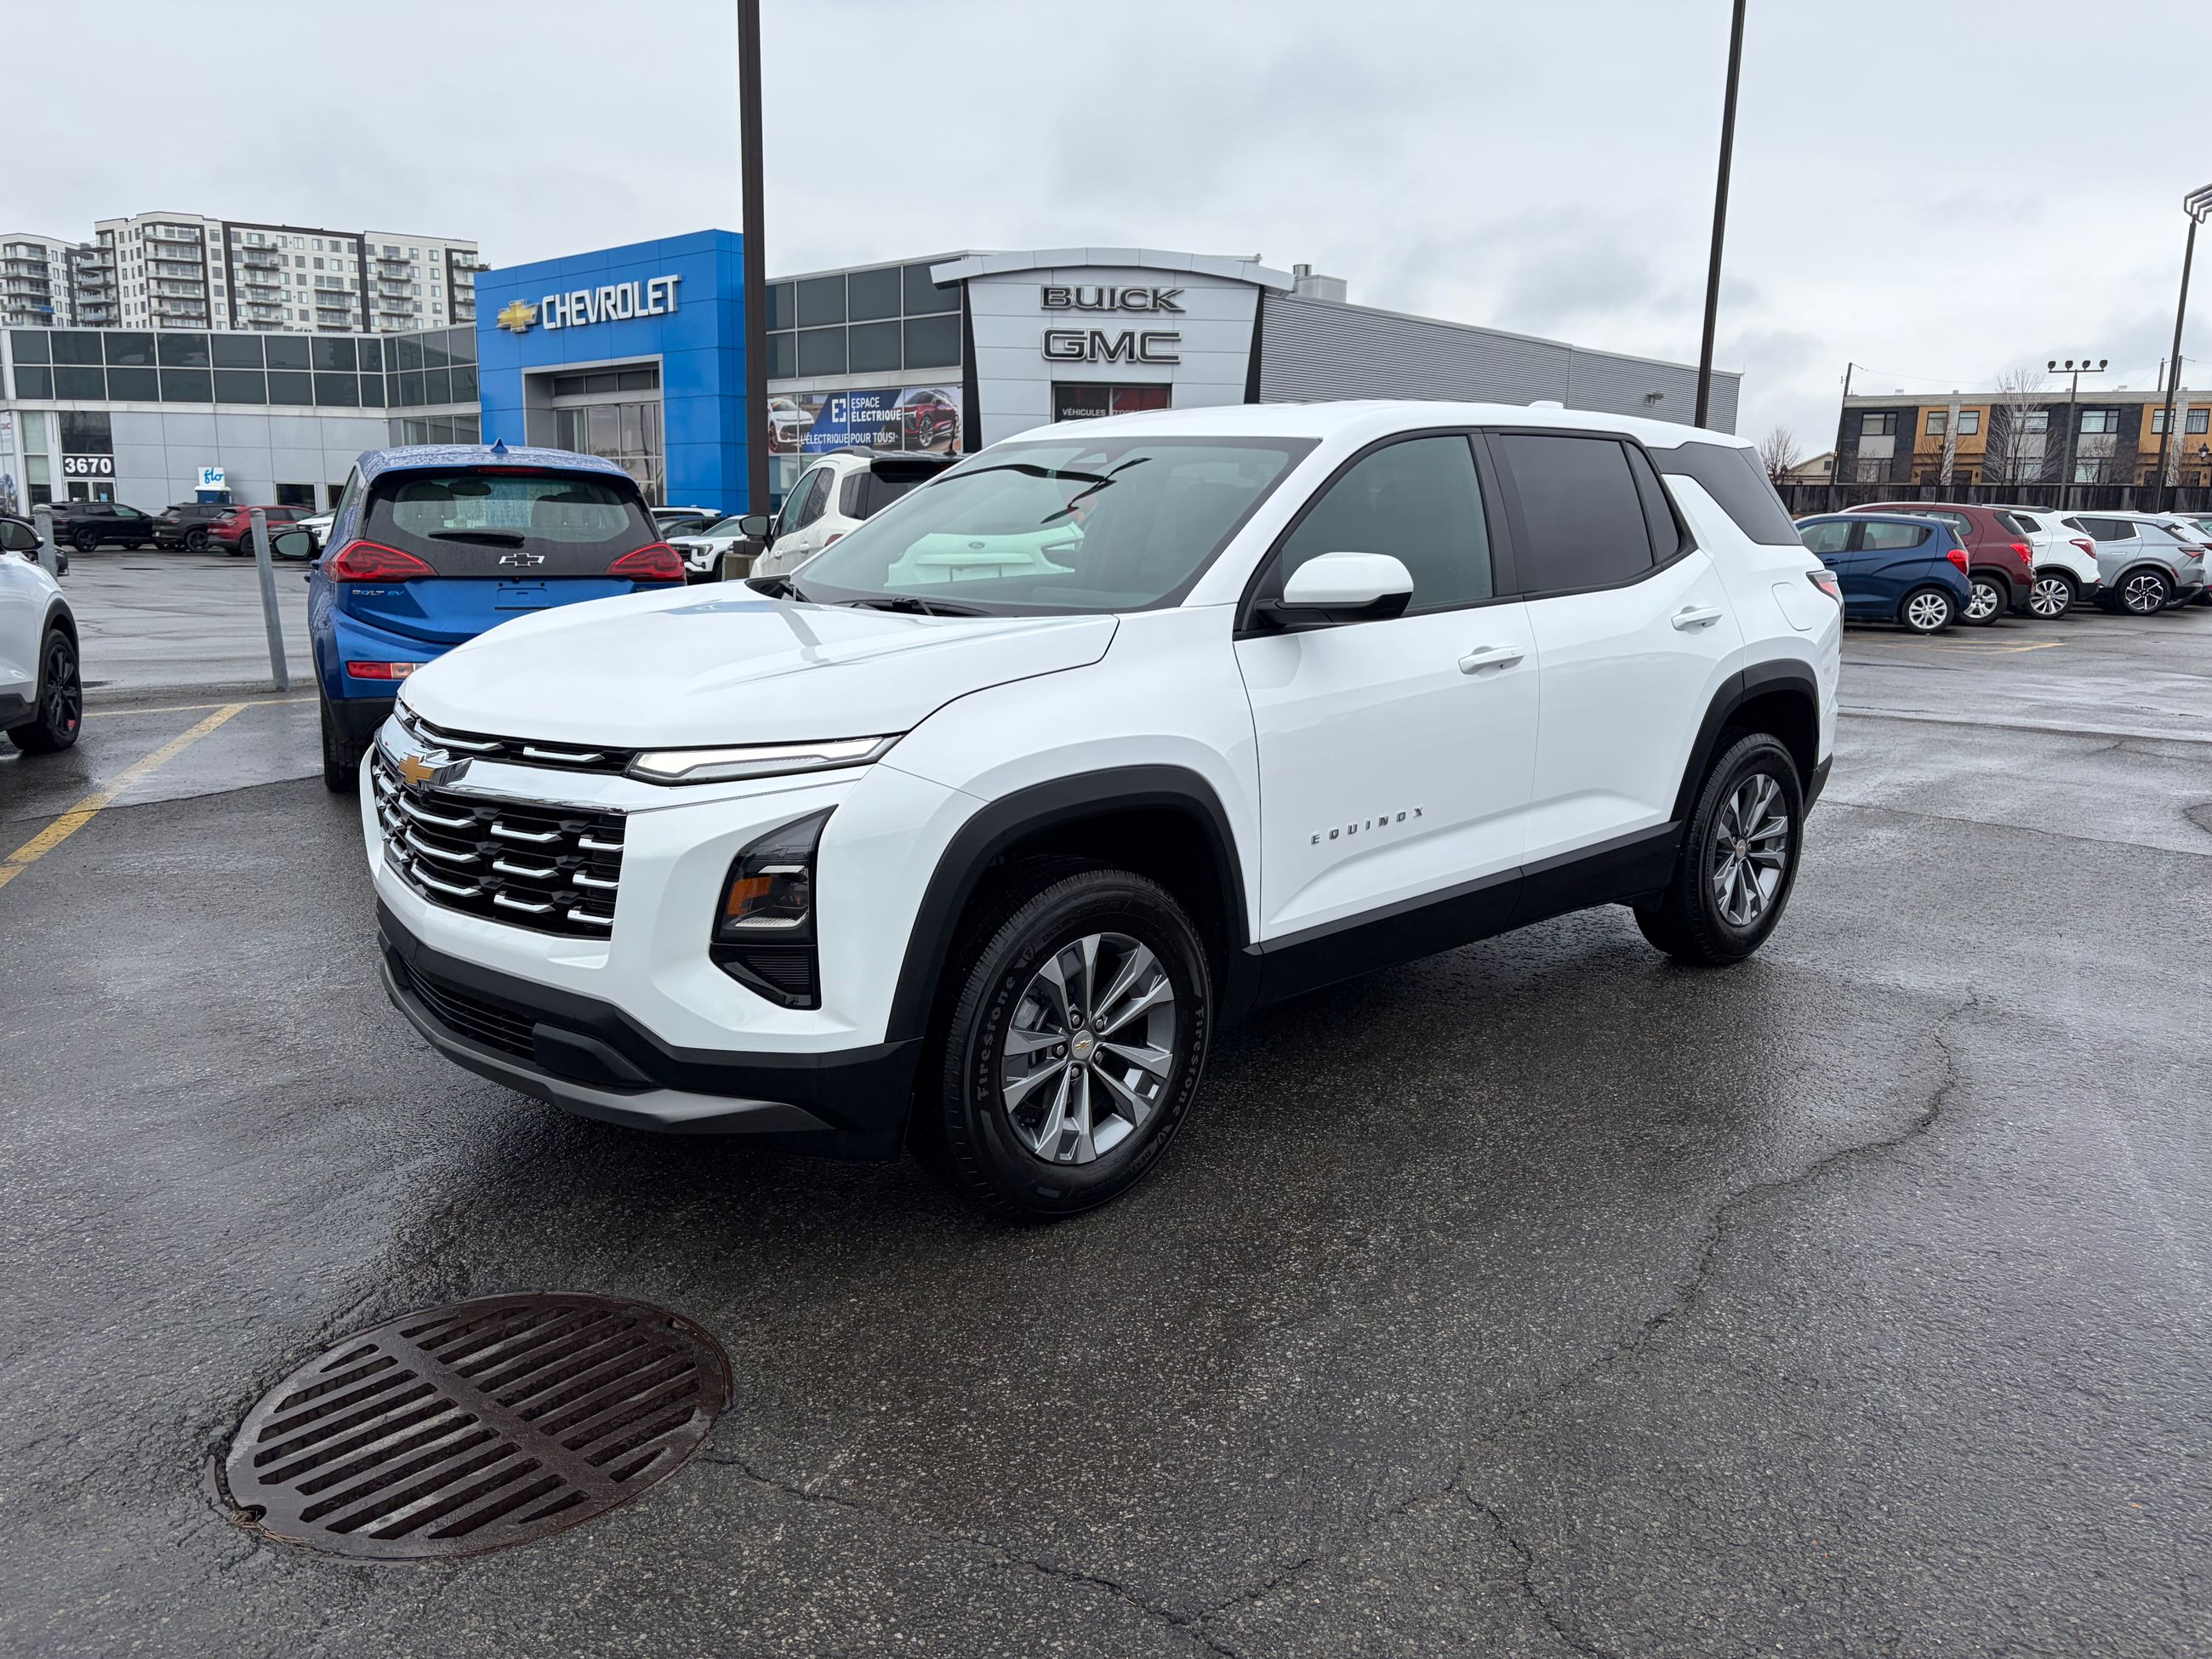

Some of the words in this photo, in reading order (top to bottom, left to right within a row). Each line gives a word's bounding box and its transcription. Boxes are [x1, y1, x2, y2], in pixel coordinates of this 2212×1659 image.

[541, 274, 680, 330] CHEVROLET
[1041, 285, 1186, 312] BUICK
[1041, 328, 1183, 364] GMC
[852, 396, 880, 408] ESPACE
[852, 406, 902, 423] ÉLECTRIQUE
[1062, 407, 1106, 417] VÉHICULES
[851, 433, 871, 443] POUR
[873, 432, 896, 443] TOUS!
[65, 458, 111, 474] 3670
[204, 467, 224, 484] flo
[1311, 807, 1422, 845] EQUINOX
